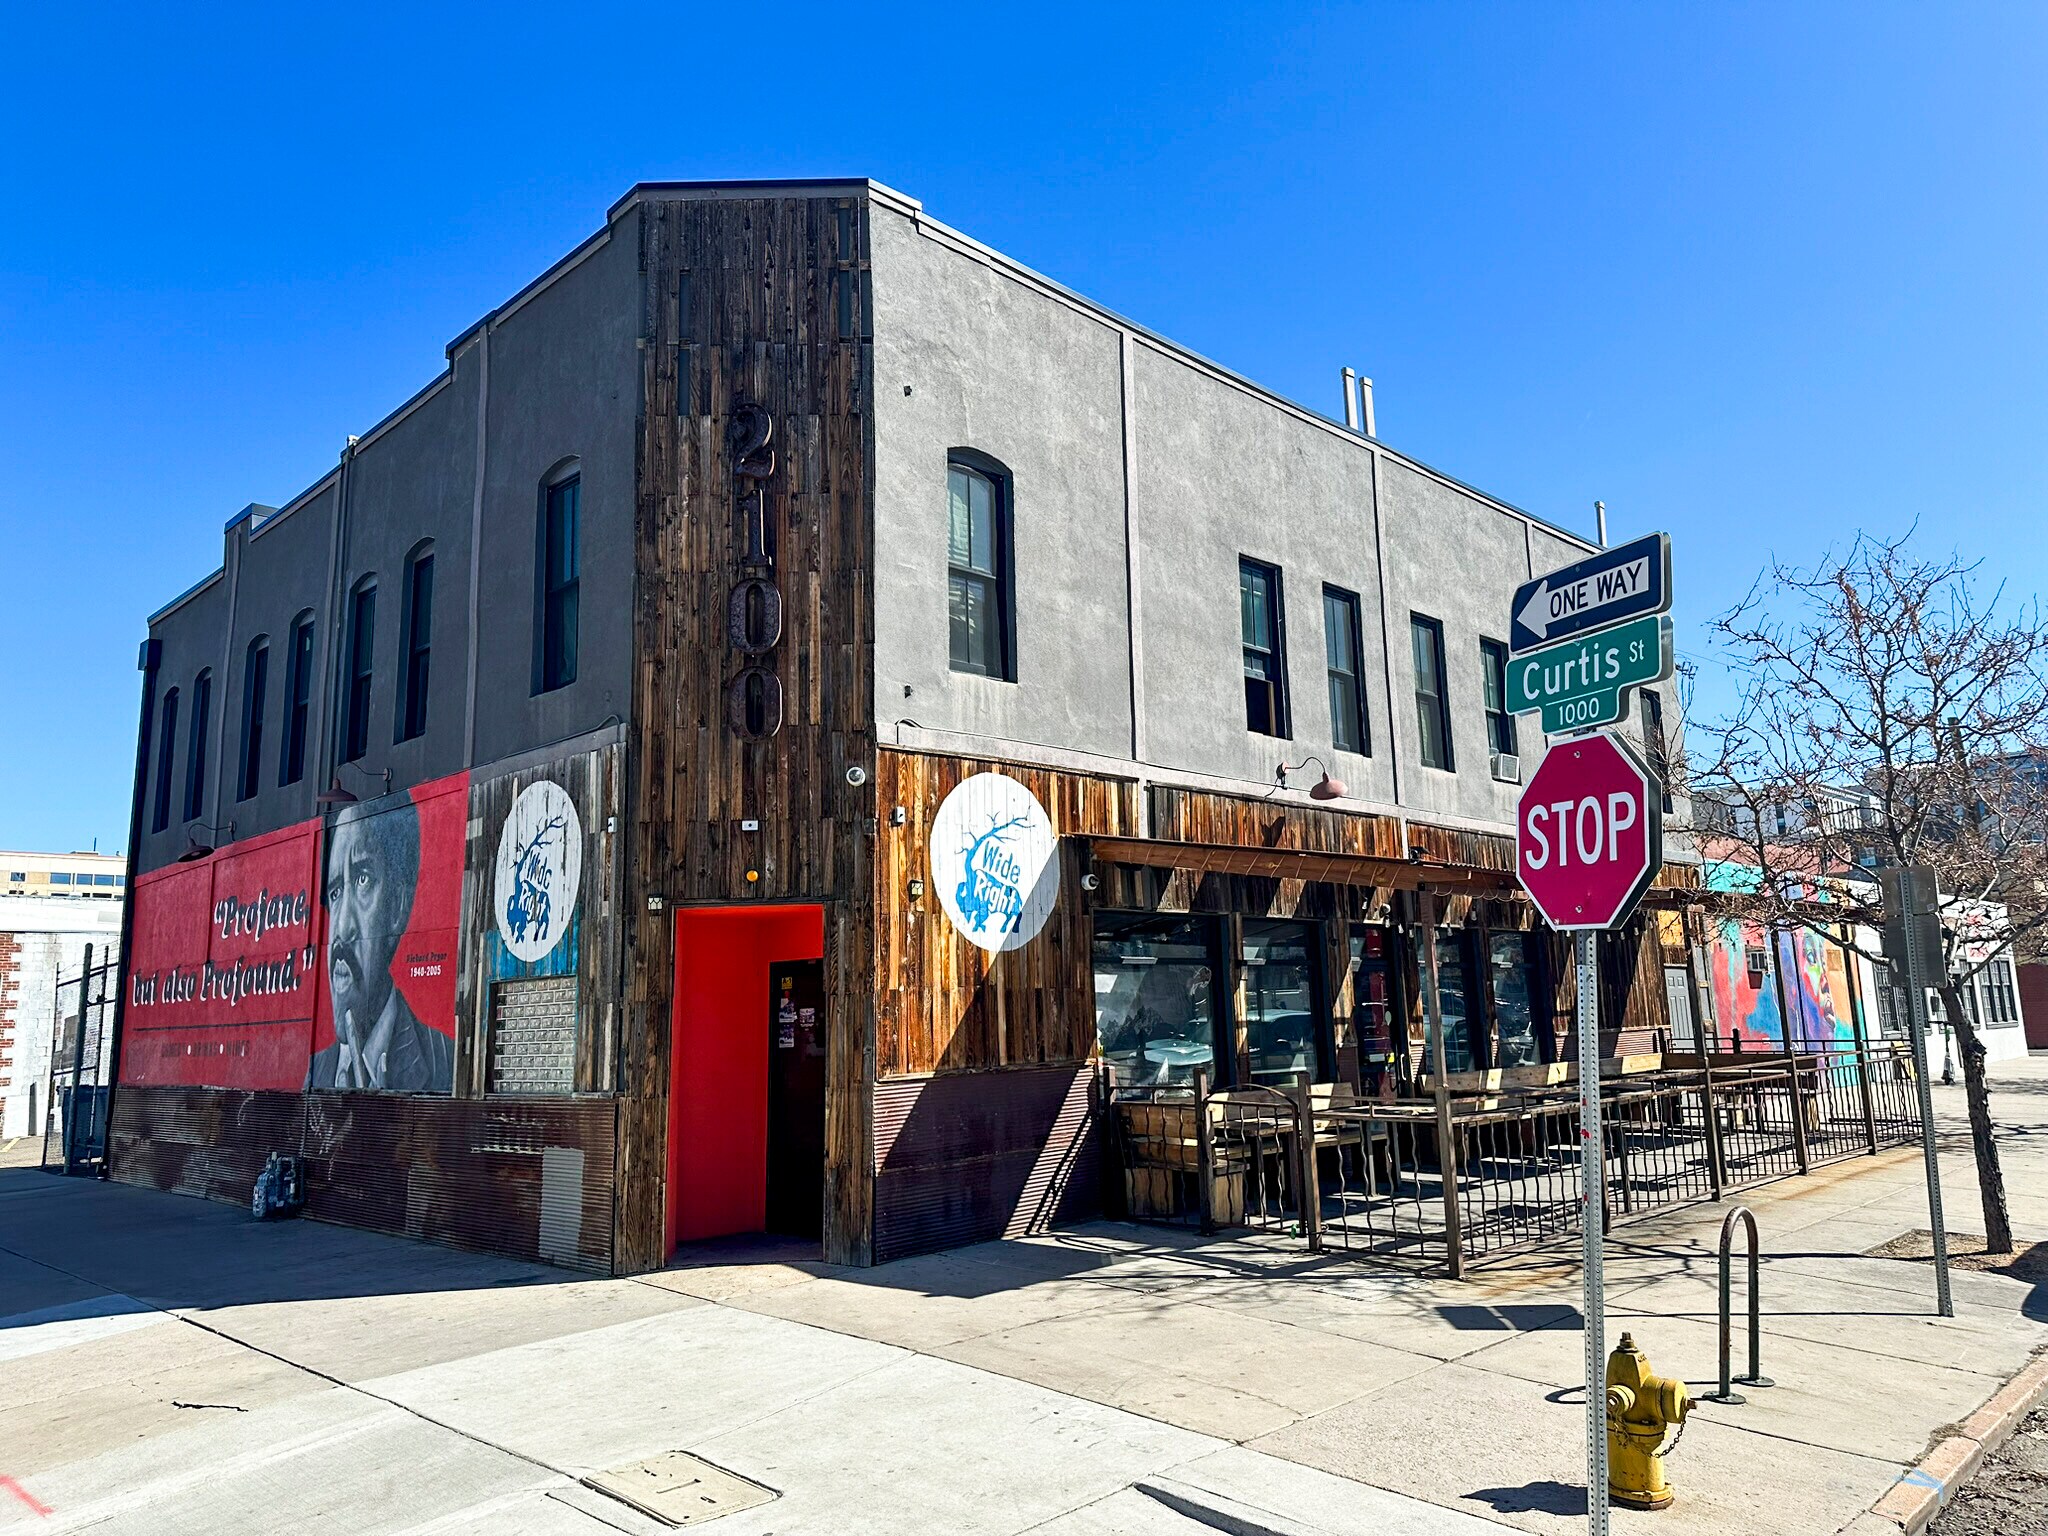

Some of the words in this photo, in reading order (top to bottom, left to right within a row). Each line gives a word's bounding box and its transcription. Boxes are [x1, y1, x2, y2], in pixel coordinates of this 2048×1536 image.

[729, 403, 782, 744] 2100
[1550, 581, 1588, 618] ONE
[1597, 562, 1643, 602] WAY
[1523, 642, 1620, 700] Curtis
[1629, 639, 1645, 662] St
[1559, 697, 1599, 726] 1000
[1525, 791, 1636, 870] STOP
[982, 840, 1021, 885] Wide
[974, 871, 1017, 915] Right
[132, 968, 159, 1007] but
[162, 964, 197, 1004] also
[410, 965, 442, 977] 1940-2005
